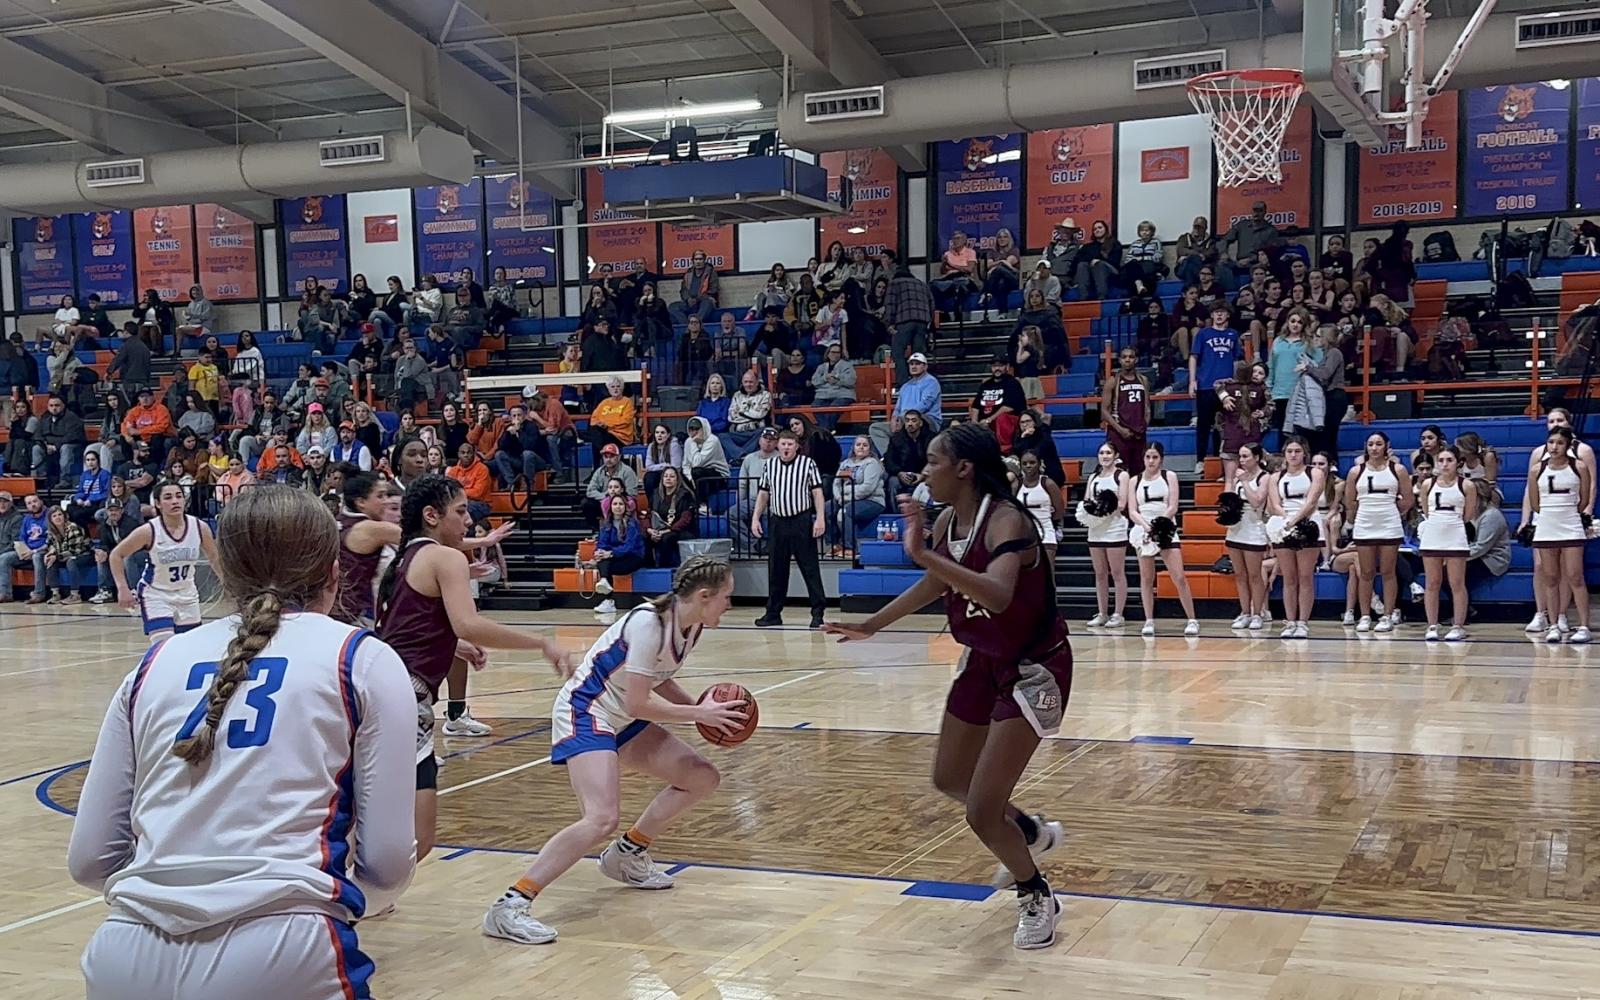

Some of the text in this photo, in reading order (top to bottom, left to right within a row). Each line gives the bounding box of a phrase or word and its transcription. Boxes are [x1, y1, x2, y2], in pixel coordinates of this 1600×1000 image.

[1476, 128, 1559, 149] FOOTBALL
[1046, 160, 1093, 171] LADY CAT
[1491, 162, 1543, 173] CHAMPION
[945, 177, 1013, 195] BASEBALL
[1051, 170, 1086, 185] GOLF
[1372, 200, 1443, 218] 2018-2019
[1496, 194, 1537, 211] 2016
[147, 240, 181, 252] TENNIS
[208, 235, 243, 249] TENNIS
[1128, 390, 1142, 403] 24
[1284, 482, 1304, 499] L
[1367, 476, 1388, 494] L
[1548, 475, 1570, 494] L
[1023, 493, 1041, 508] L
[1143, 486, 1164, 503] L
[1435, 492, 1456, 511] L
[169, 565, 190, 582] 30
